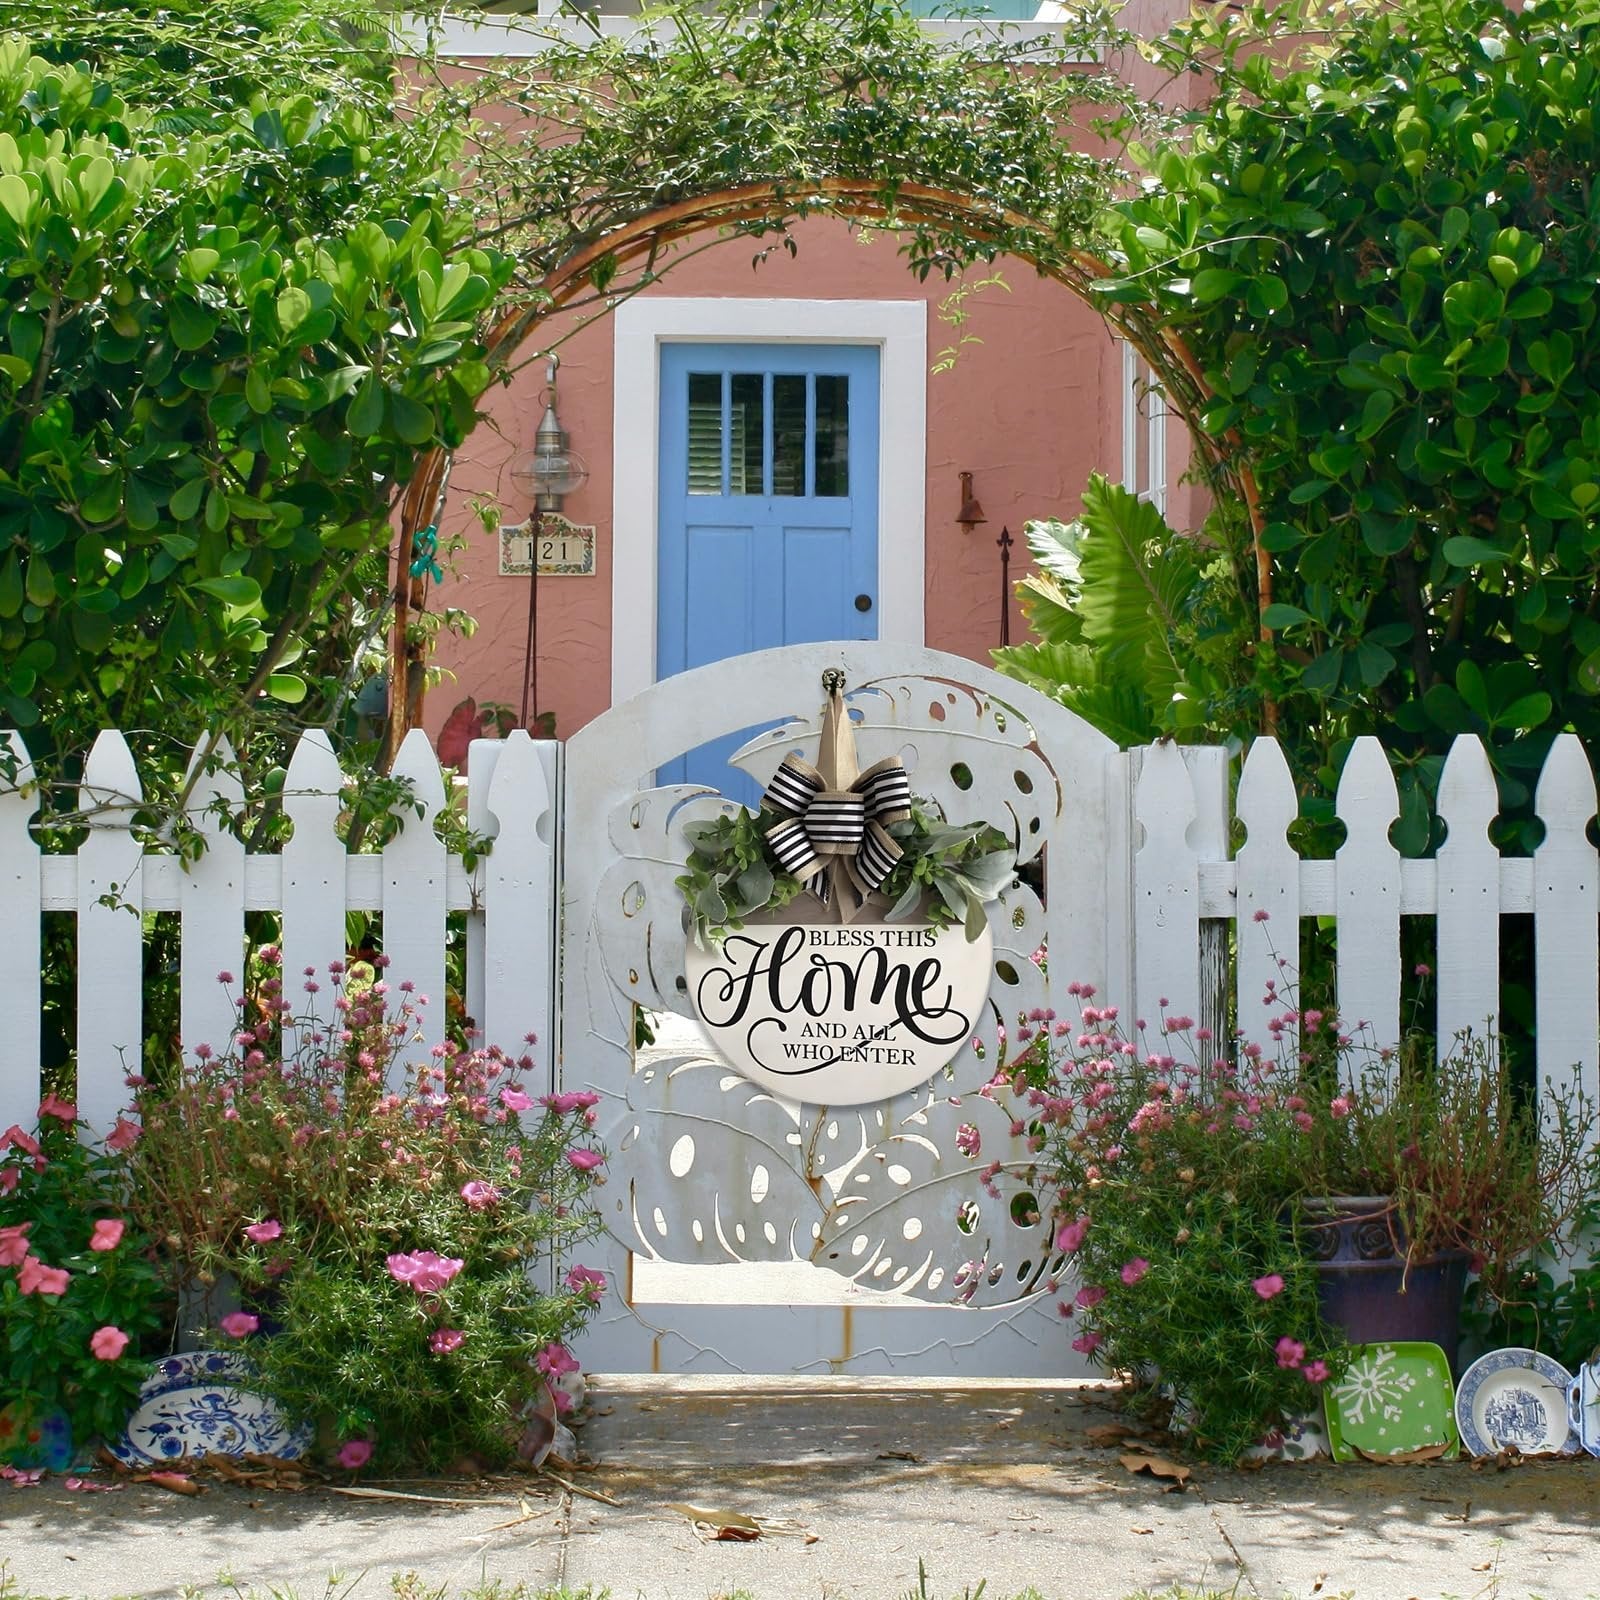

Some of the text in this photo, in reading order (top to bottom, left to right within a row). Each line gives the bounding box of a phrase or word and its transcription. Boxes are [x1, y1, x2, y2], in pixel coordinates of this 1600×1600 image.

[527, 541, 567, 560] 121
[809, 930, 937, 947] BLESS THIS
[698, 926, 970, 1045] Home
[800, 1022, 897, 1042] AND ALL
[783, 1043, 917, 1066] WHO ENTER
